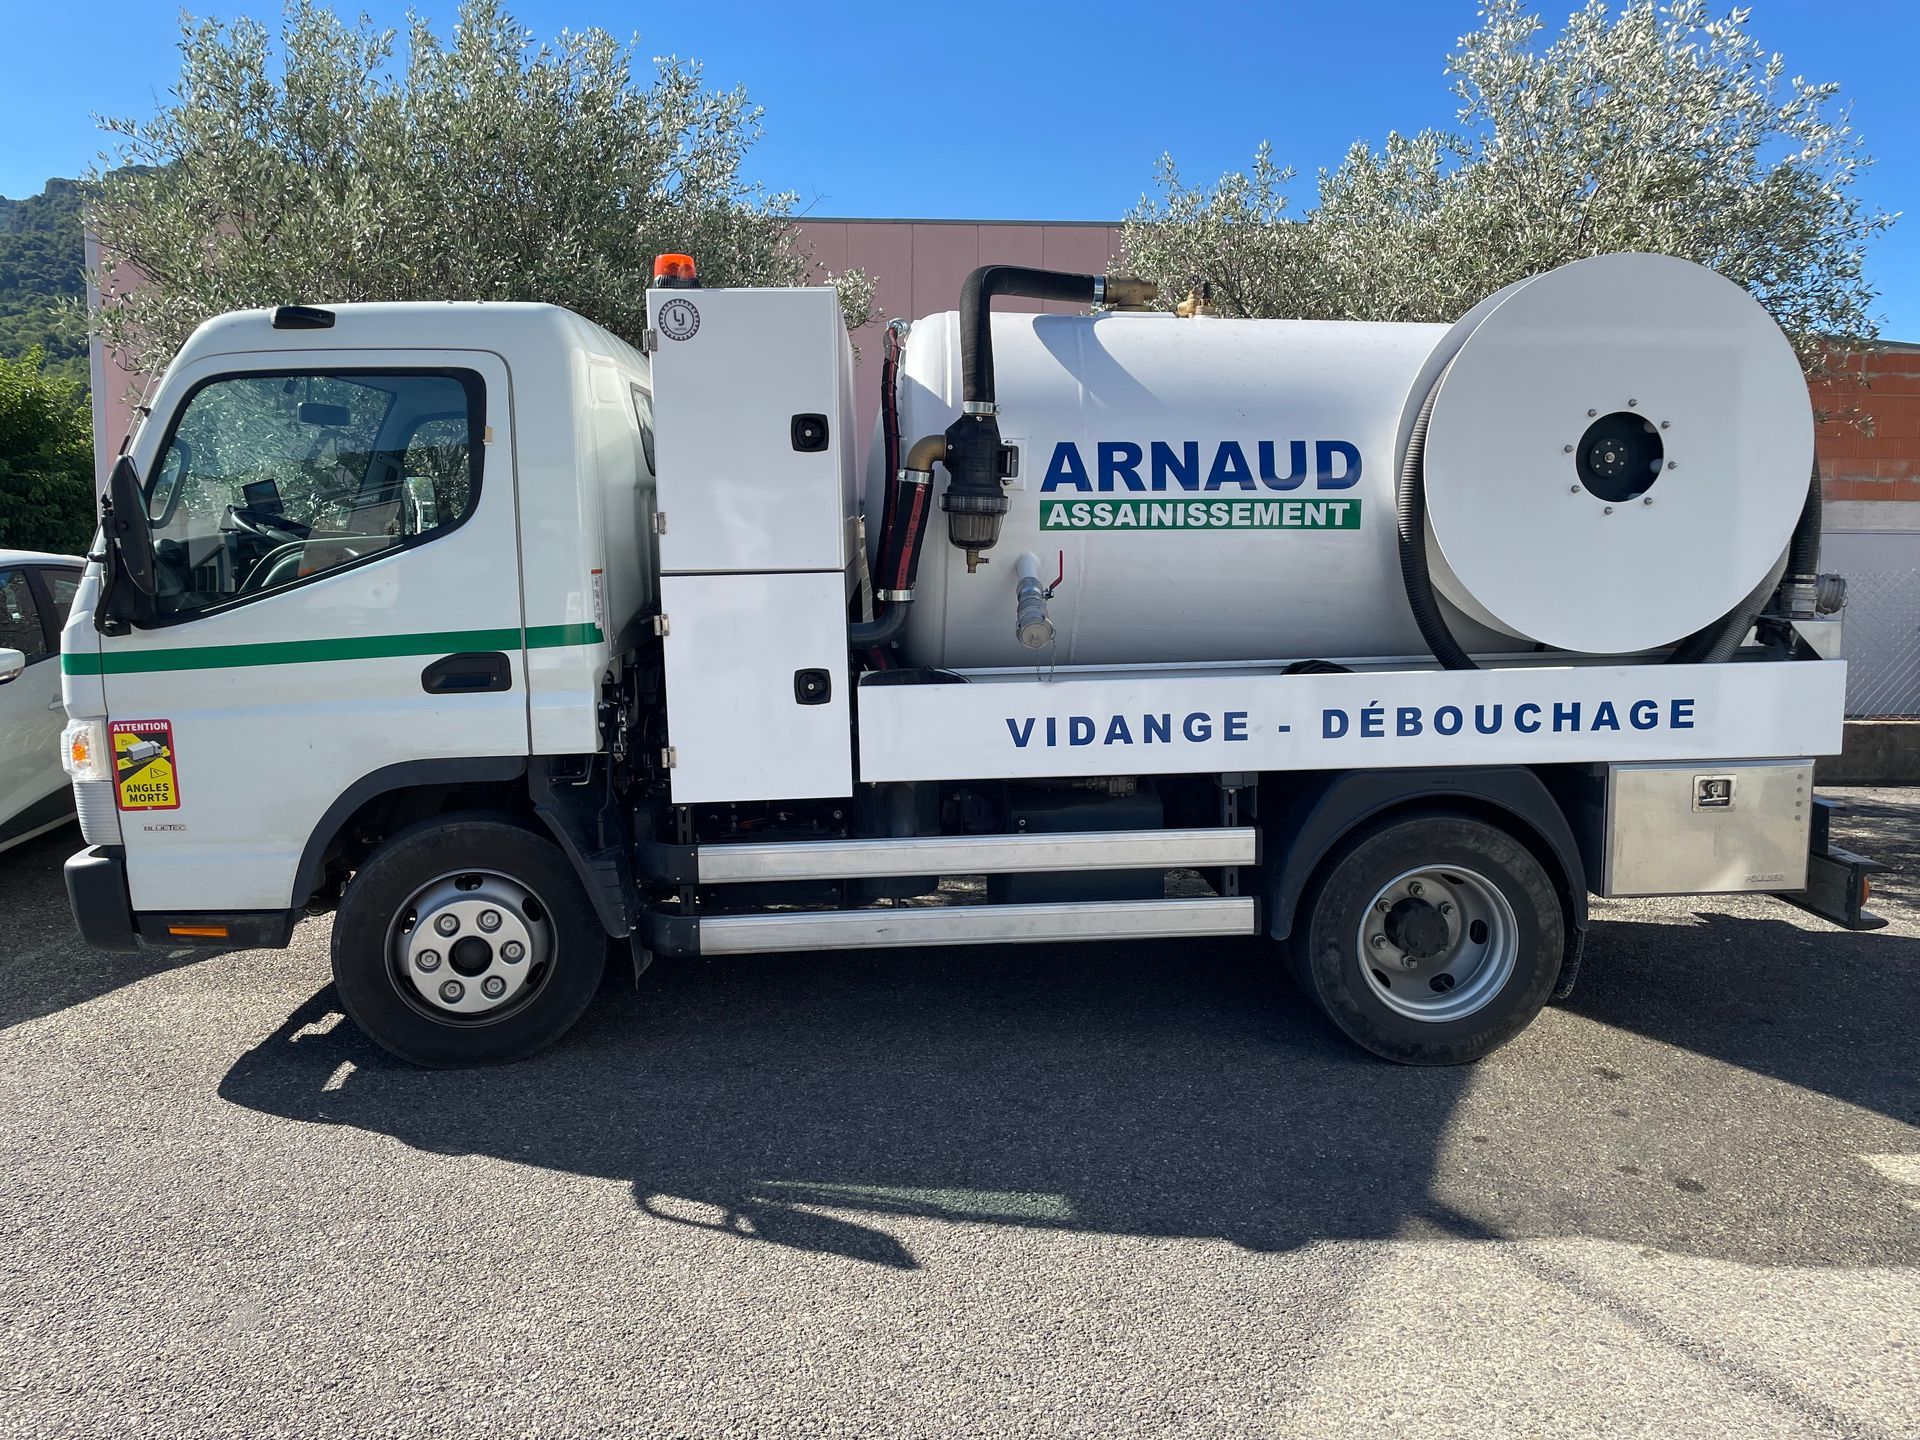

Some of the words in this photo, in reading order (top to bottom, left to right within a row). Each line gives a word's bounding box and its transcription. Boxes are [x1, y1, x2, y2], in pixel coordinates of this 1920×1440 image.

[1040, 440, 1362, 491] ARNAUD
[1046, 502, 1350, 527] ASSAINISSEMENT
[113, 722, 168, 732] ATTENTION
[1006, 711, 1249, 748] VIDANGE
[1322, 698, 1695, 739] DÉBOUCHAGE
[126, 783, 169, 793] ANGLES
[129, 793, 169, 802] MORTS
